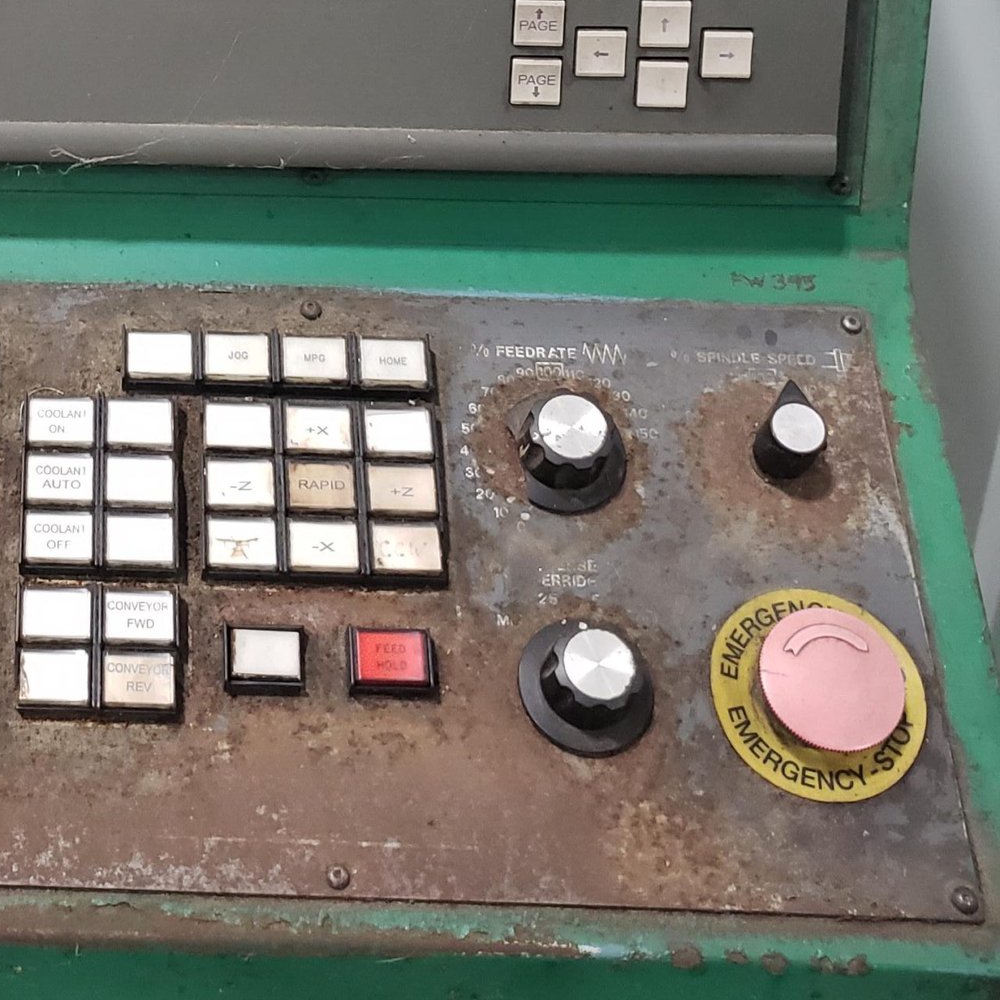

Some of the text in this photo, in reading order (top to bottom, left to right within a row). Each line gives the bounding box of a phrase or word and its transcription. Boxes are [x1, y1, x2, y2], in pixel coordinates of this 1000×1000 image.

[519, 20, 558, 32] PAGE
[517, 74, 556, 86] PAGE
[227, 350, 249, 361] JOG
[303, 352, 327, 363] MPG
[496, 346, 578, 360] FEEDRATE
[378, 356, 408, 367] HOME
[48, 424, 66, 434] ON
[305, 425, 330, 436] +X
[42, 479, 81, 490] AUTO
[297, 478, 346, 491] RAPID
[390, 486, 415, 498] +Z
[46, 539, 71, 550] OFF
[106, 600, 169, 613] CONVEYOR
[126, 617, 155, 630] FWD
[721, 600, 832, 681] EMERGEN
[375, 643, 407, 655] FEED
[106, 662, 171, 677] CONVEYOR
[376, 660, 408, 671] HOLD
[125, 680, 153, 693] REV
